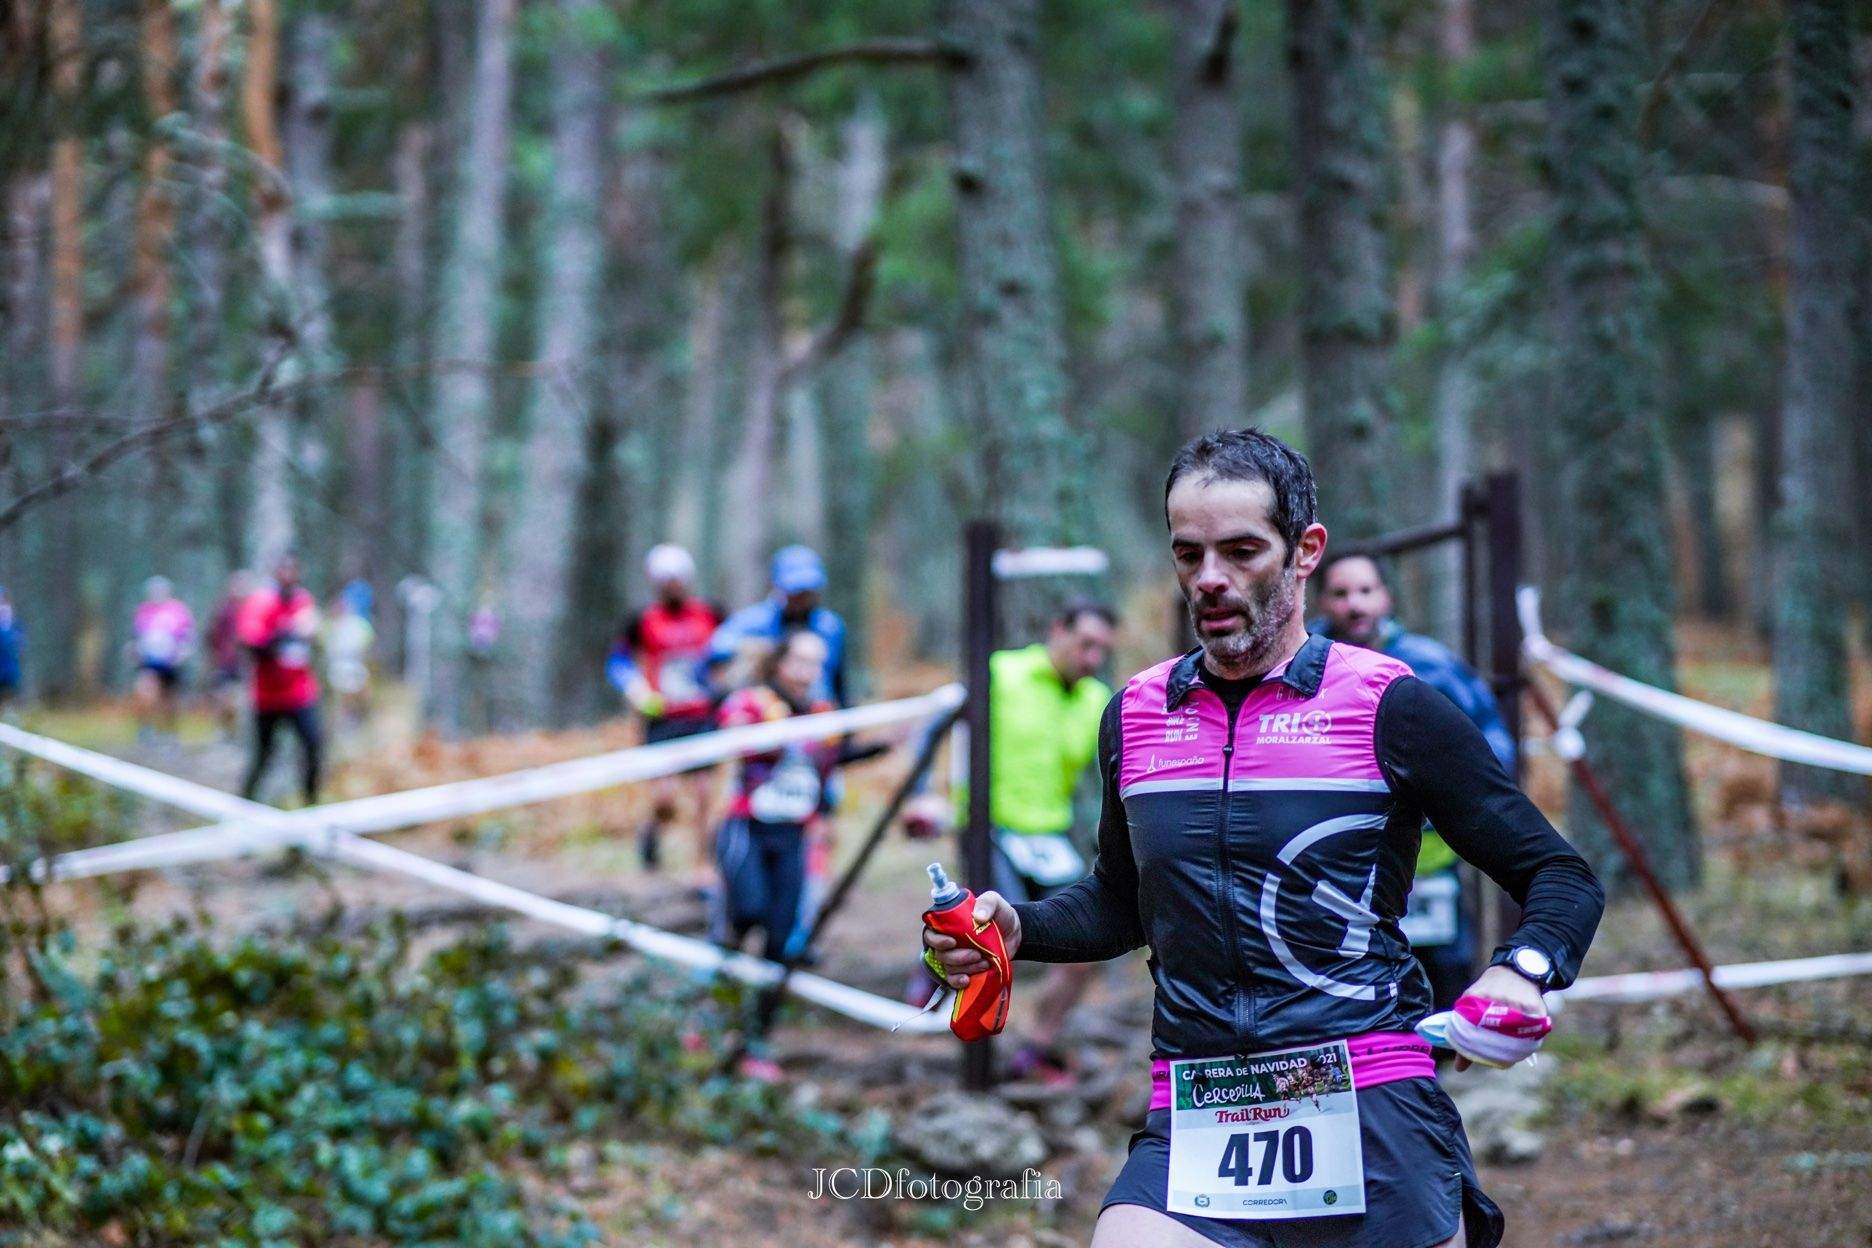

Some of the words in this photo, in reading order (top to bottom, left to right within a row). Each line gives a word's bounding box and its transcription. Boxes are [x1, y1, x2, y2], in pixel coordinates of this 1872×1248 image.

[1256, 735, 1332, 745] MORALZARZAL
[1182, 1067, 1234, 1081] CARERA
[1235, 1067, 1249, 1077] DE
[1250, 1057, 1308, 1075] NAVIDAD
[1215, 1107, 1250, 1124] Trail
[1249, 1107, 1290, 1122] Run
[1217, 1125, 1314, 1187] 470
